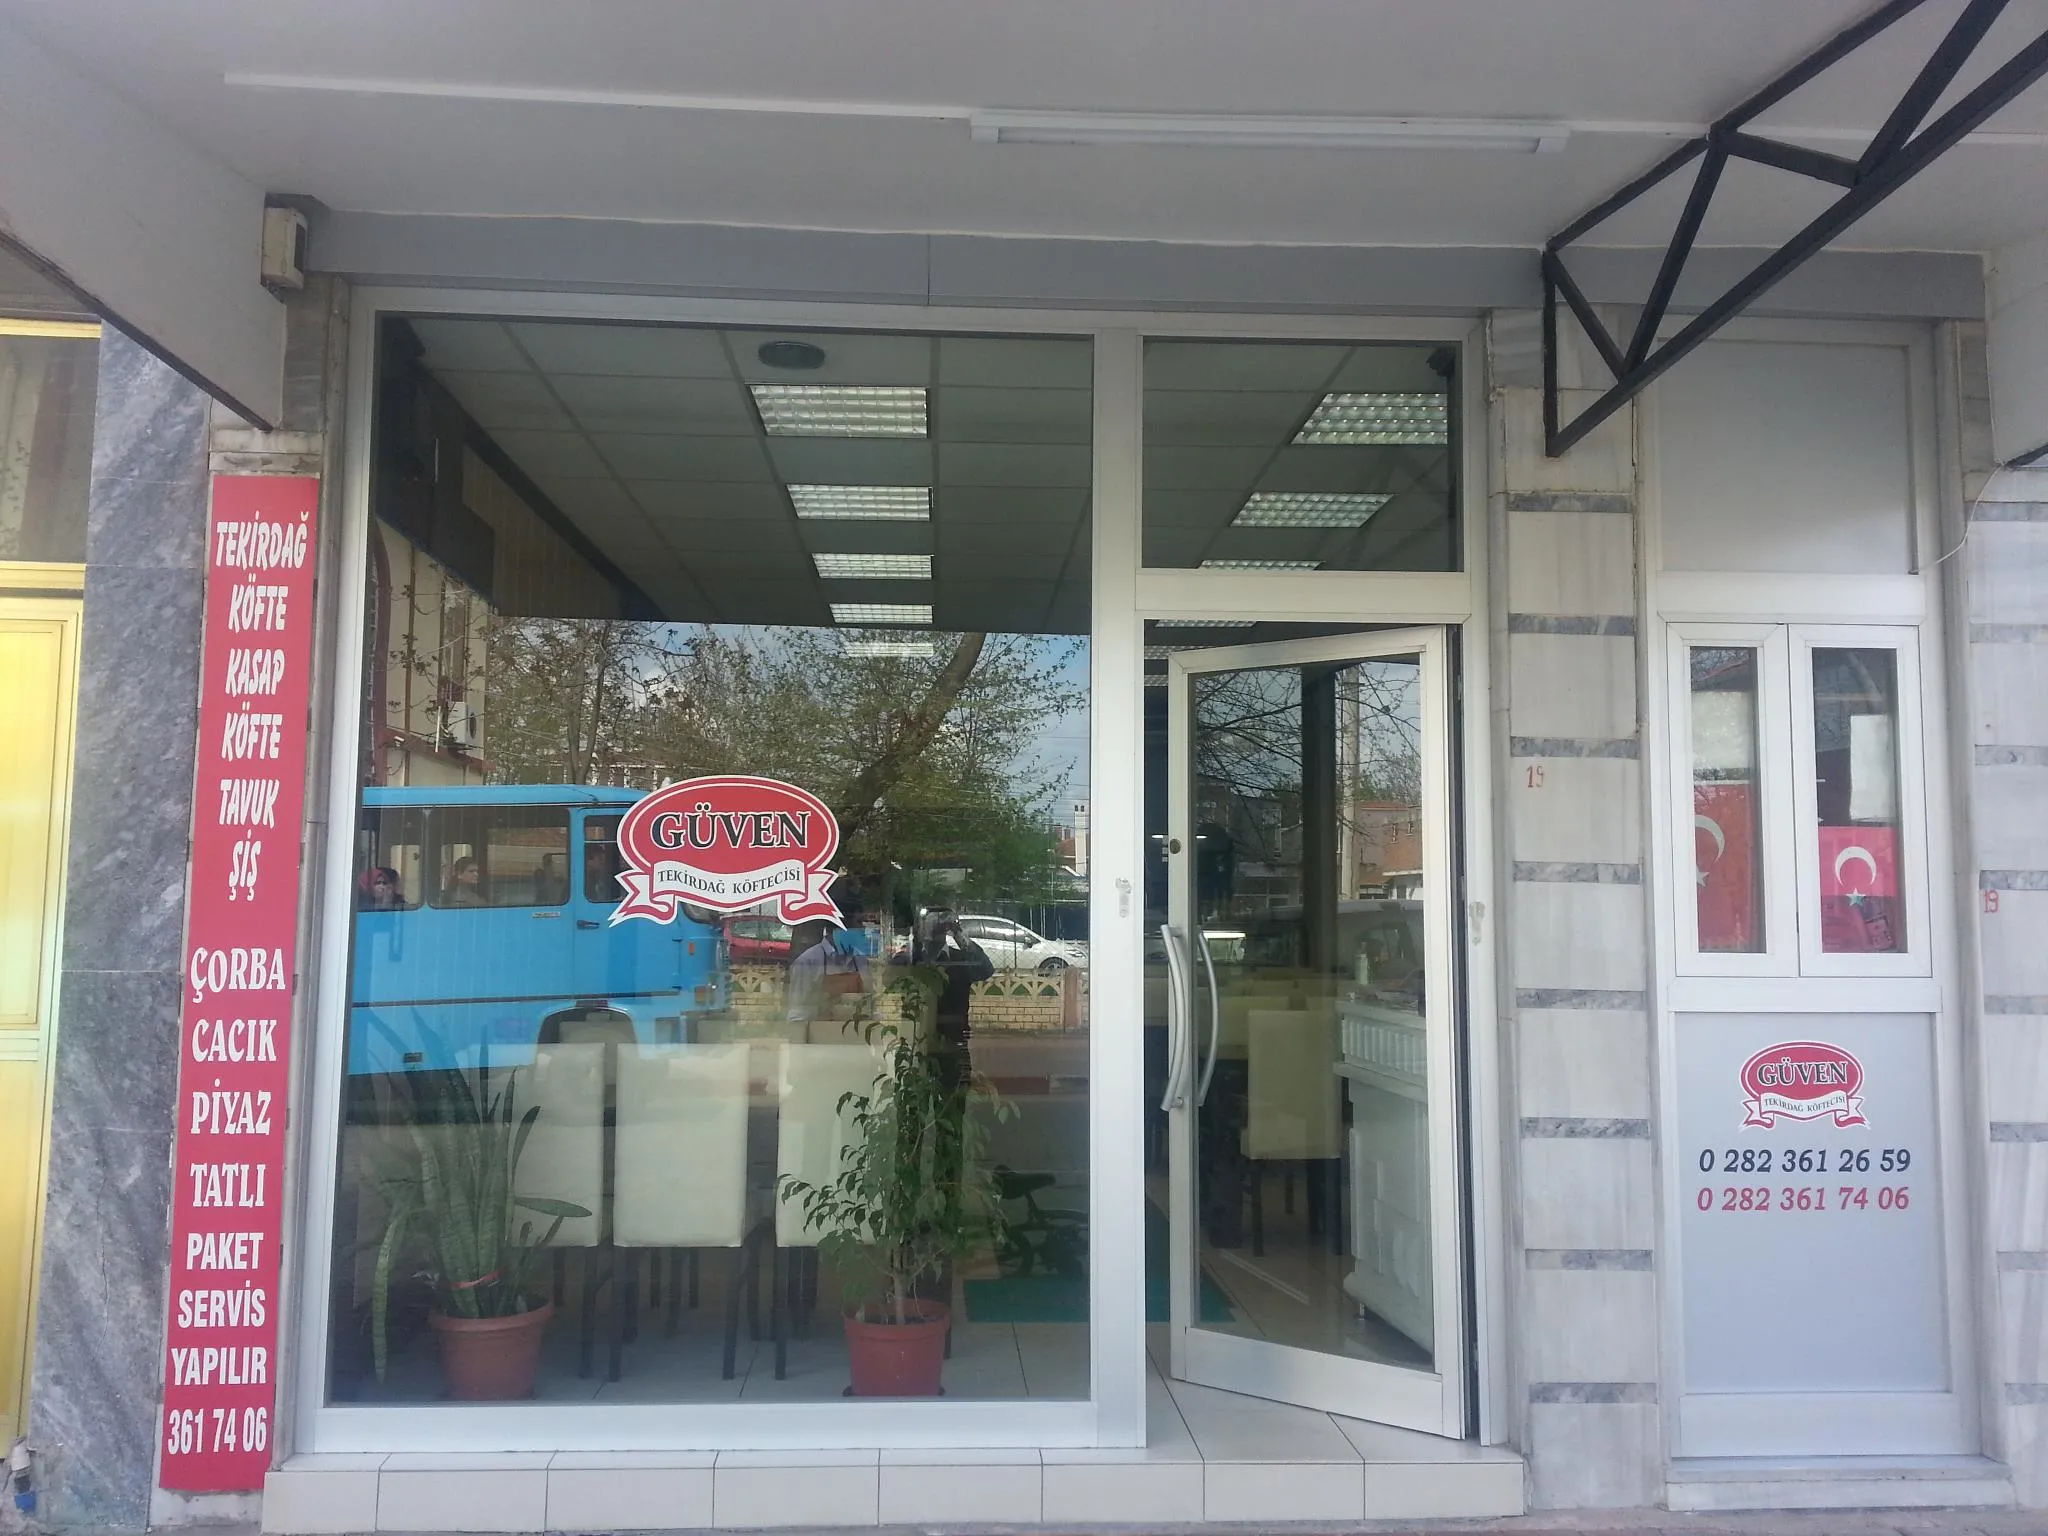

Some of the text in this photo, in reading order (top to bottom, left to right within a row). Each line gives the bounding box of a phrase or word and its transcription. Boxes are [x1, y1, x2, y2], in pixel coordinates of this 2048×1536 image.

[215, 511, 309, 569] TEKİRDAĞ
[228, 573, 289, 633] KÖFTE
[225, 648, 285, 697] KASAP
[221, 703, 283, 762] KÖFTE
[218, 779, 280, 829] TAVUK
[651, 802, 810, 849] GÜVEN
[228, 830, 261, 901] ŞİŞ
[657, 866, 802, 894] TEKİRDAĞ KÖFTECİSİ
[190, 947, 286, 1003] ÇORBA
[191, 1018, 277, 1063] CACIK
[1757, 1057, 1848, 1086] GÜVEN
[190, 1079, 272, 1135] PİYAZ
[1699, 1149, 1912, 1173] 0 282 361 26 59
[190, 1163, 265, 1208] TATLI
[1697, 1186, 1910, 1212] 0 282 361 74 06
[186, 1232, 264, 1270] PAKET
[177, 1279, 266, 1328] SERVİS
[171, 1347, 267, 1386] YAPILIR
[167, 1407, 268, 1455] 361 74 06
